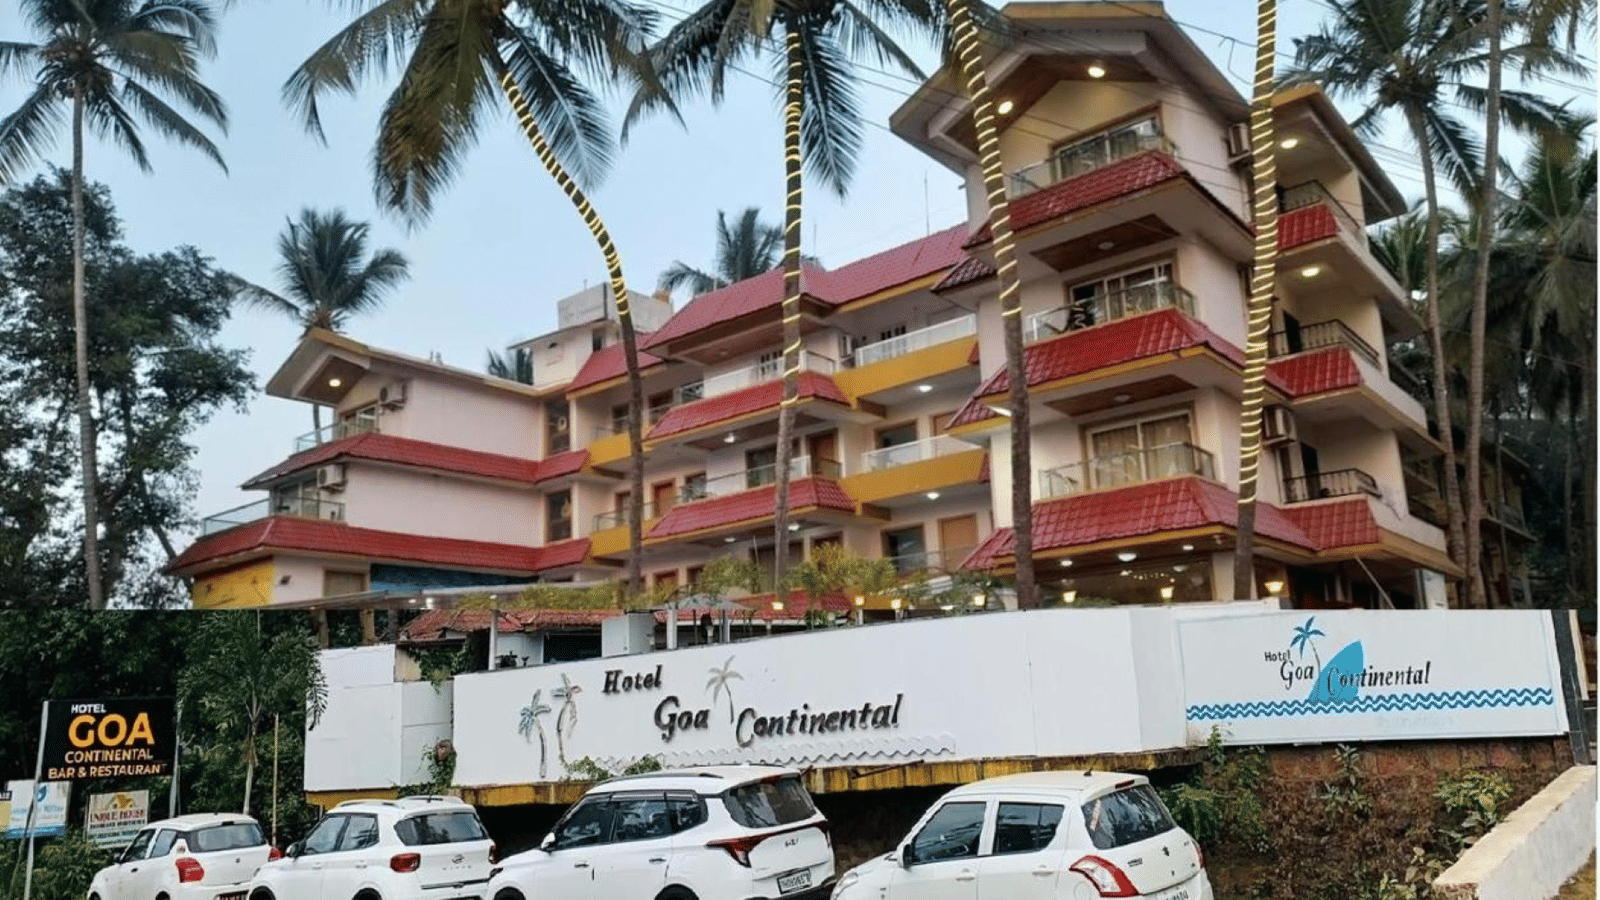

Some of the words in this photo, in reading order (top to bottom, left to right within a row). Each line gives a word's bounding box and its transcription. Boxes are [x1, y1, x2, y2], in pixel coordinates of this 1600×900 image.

[1264, 649, 1291, 662] Hotel
[602, 665, 662, 695] Hotel
[1280, 661, 1314, 690] Goa
[1327, 661, 1431, 696] Continental
[71, 703, 107, 714] HOTEL
[68, 712, 155, 748] GOA
[654, 696, 710, 742] Goa
[735, 693, 903, 748] Continental
[64, 748, 153, 764] CONTINENTAL
[48, 767, 75, 779] BAR
[77, 767, 87, 778] &
[89, 763, 168, 777] RESTAURANT
